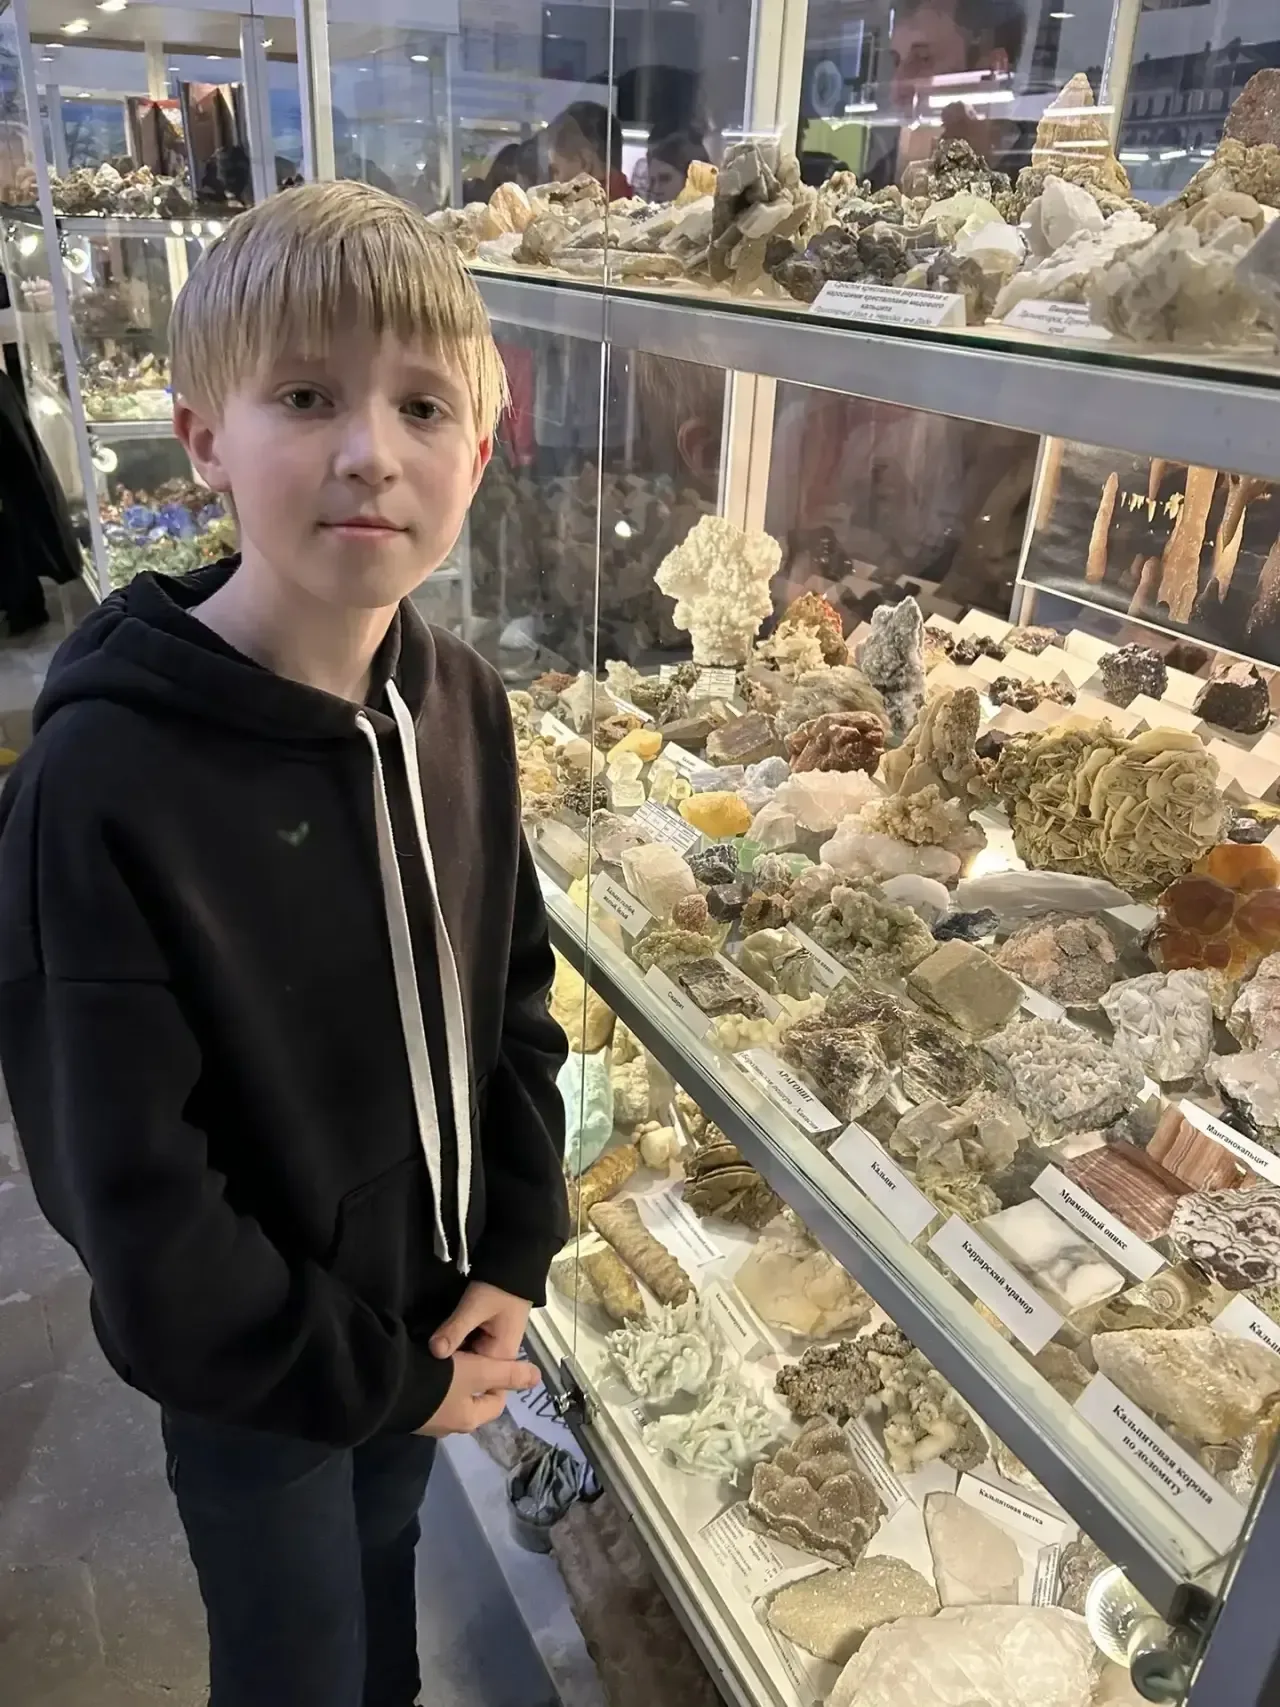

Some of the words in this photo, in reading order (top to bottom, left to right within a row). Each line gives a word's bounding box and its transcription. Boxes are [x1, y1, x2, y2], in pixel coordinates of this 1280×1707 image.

[777, 1069, 815, 1103] АРАГОНИТ
[1206, 1124, 1269, 1167] Манганокальцит
[871, 1161, 897, 1190] Кальцит
[1059, 1188, 1106, 1231] Мраморный
[1104, 1228, 1128, 1251] оникс
[962, 1240, 1006, 1286] Каррарский
[1004, 1283, 1034, 1315] мрамор
[1113, 1404, 1176, 1469] Кальцитовая
[1176, 1467, 1213, 1505] корона
[1122, 1436, 1136, 1450] по
[1134, 1449, 1184, 1496] доломиту
[979, 1488, 1022, 1515] Кальцитовая
